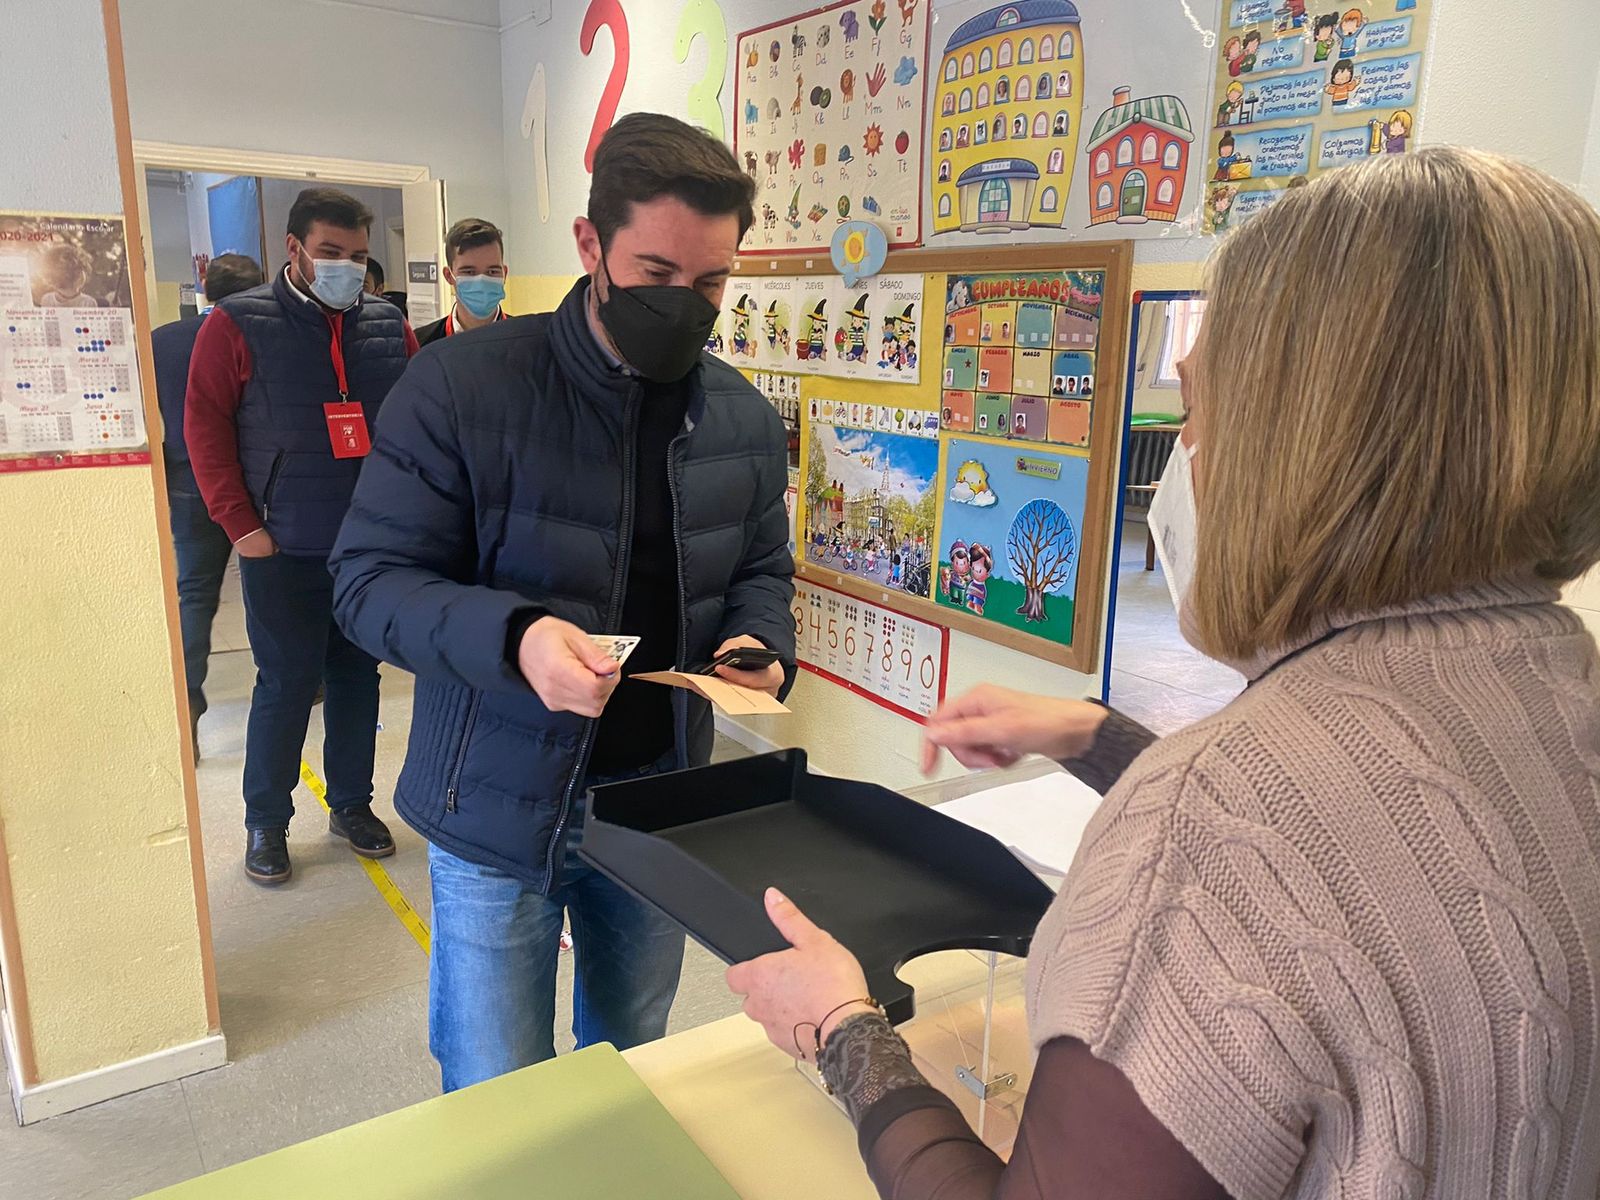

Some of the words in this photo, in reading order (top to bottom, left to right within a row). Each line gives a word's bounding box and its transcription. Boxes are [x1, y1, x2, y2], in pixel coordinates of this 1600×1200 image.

[1396, 61, 1409, 71] las
[1364, 75, 1388, 84] cosas
[1390, 73, 1404, 84] por
[1384, 81, 1412, 92] damos
[1296, 90, 1316, 98] mesa
[1372, 93, 1404, 106] gracias
[1324, 138, 1363, 150] Colgamos
[805, 282, 824, 290] JUEVES
[879, 279, 904, 289] SÁBADO
[972, 276, 1072, 303] CUMPLEAÑOS
[894, 292, 921, 301] DOMINGO
[810, 610, 821, 642] 4
[828, 619, 838, 648] 5
[845, 626, 855, 656] 6
[864, 632, 874, 664] 7
[882, 639, 893, 672] 8
[901, 649, 912, 681] 9
[920, 654, 935, 689] 0
